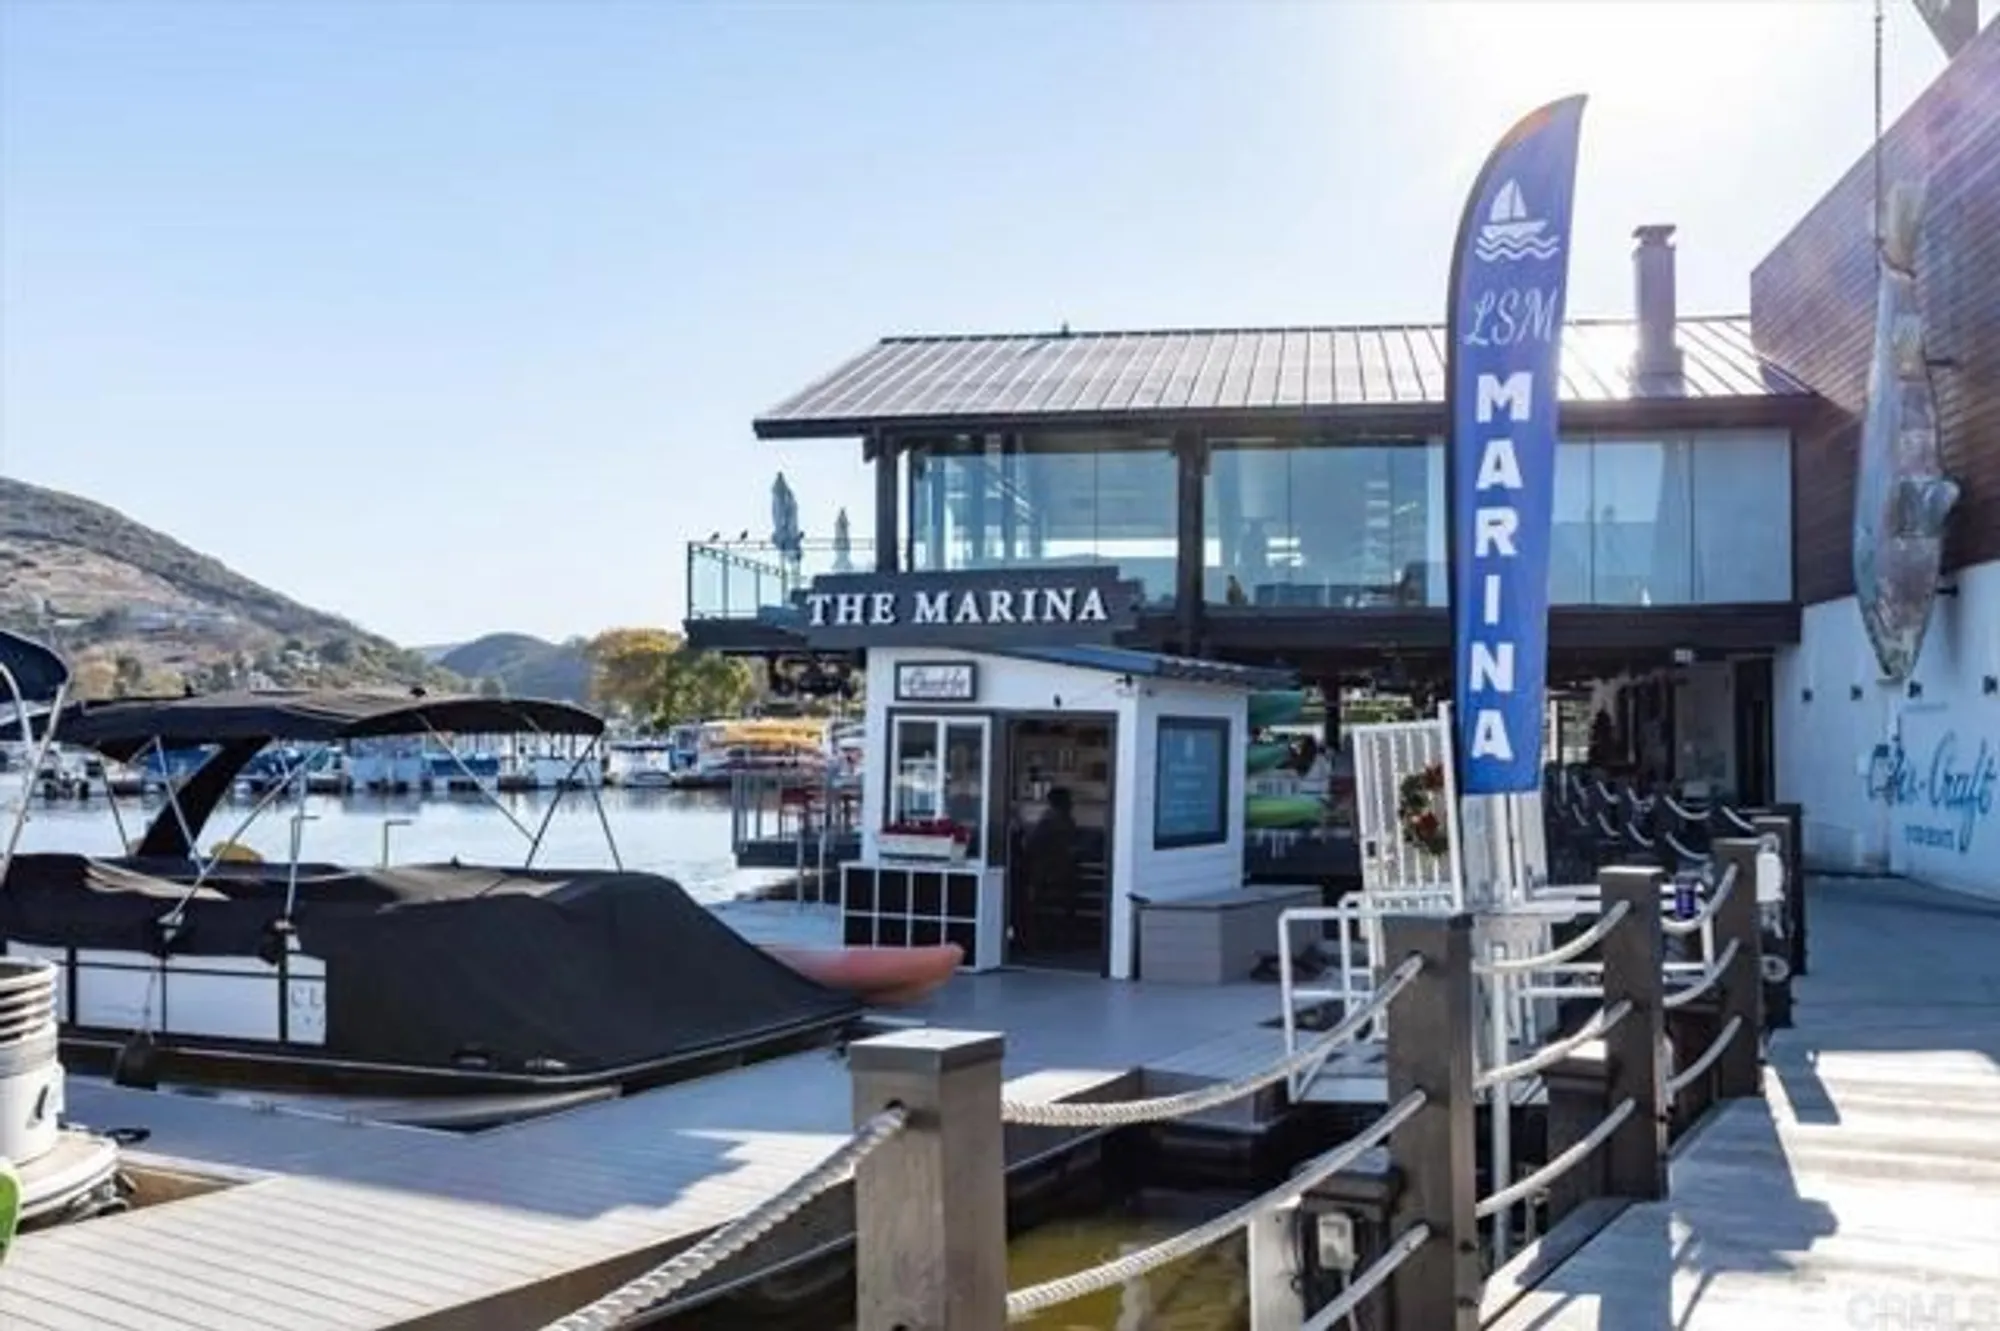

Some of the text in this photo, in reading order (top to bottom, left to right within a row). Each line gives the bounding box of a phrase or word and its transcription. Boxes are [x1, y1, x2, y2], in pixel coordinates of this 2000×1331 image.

[1464, 287, 1558, 346] LSM
[1469, 371, 1533, 762] MARINA
[806, 587, 1108, 627] THE MARINA
